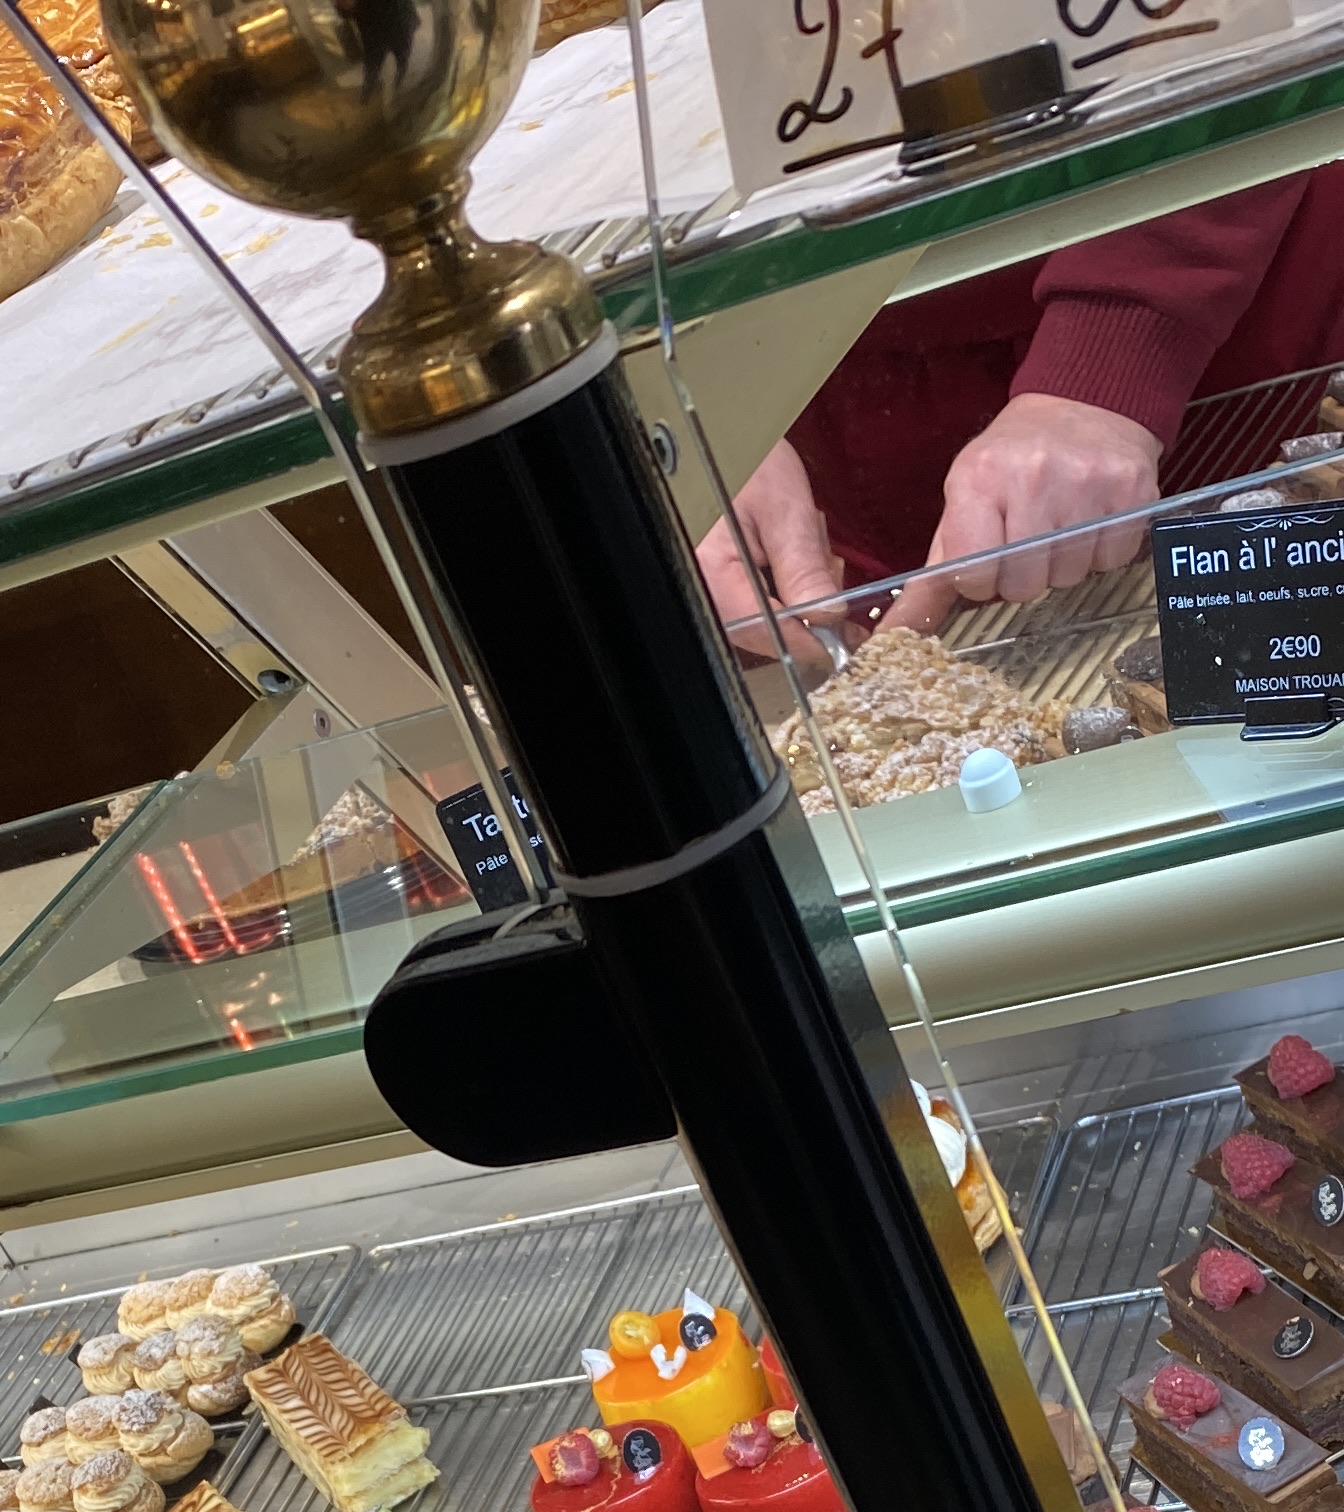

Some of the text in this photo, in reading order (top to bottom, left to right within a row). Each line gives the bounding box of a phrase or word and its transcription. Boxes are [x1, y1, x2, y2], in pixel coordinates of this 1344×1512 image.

[1171, 546, 1229, 577] Flan
[1239, 541, 1256, 570] à
[1264, 537, 1276, 567] l'
[1169, 596, 1194, 610] Pâte
[1269, 635, 1321, 660] 2€90
[1235, 677, 1289, 693] MAISON
[476, 854, 508, 875] Pâte
